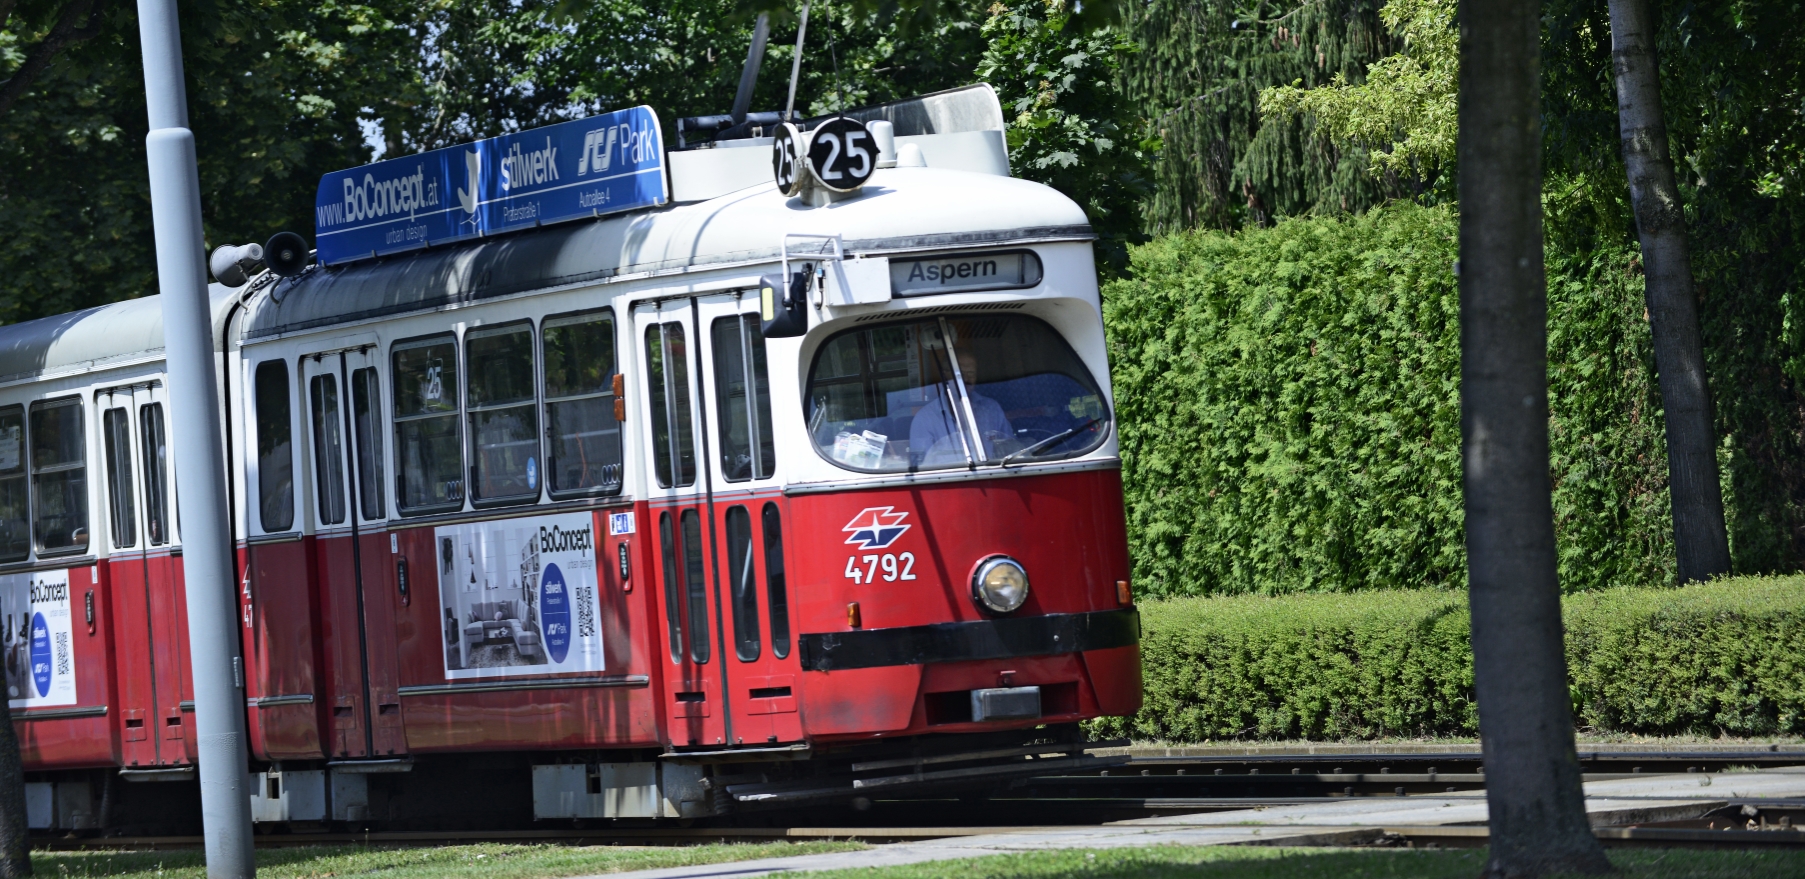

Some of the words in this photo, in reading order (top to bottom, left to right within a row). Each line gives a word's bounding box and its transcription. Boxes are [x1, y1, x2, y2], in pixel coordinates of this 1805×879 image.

[619, 118, 656, 166] Park
[817, 131, 870, 180] 25
[501, 135, 560, 191] stilwerk
[774, 137, 794, 186] 25
[385, 227, 405, 245] urban
[405, 222, 428, 242] design
[907, 259, 997, 285] Aspern
[427, 366, 442, 400] 25
[540, 523, 592, 558] BoConcept
[844, 551, 917, 585] 4792
[30, 578, 68, 607] BoConcept
